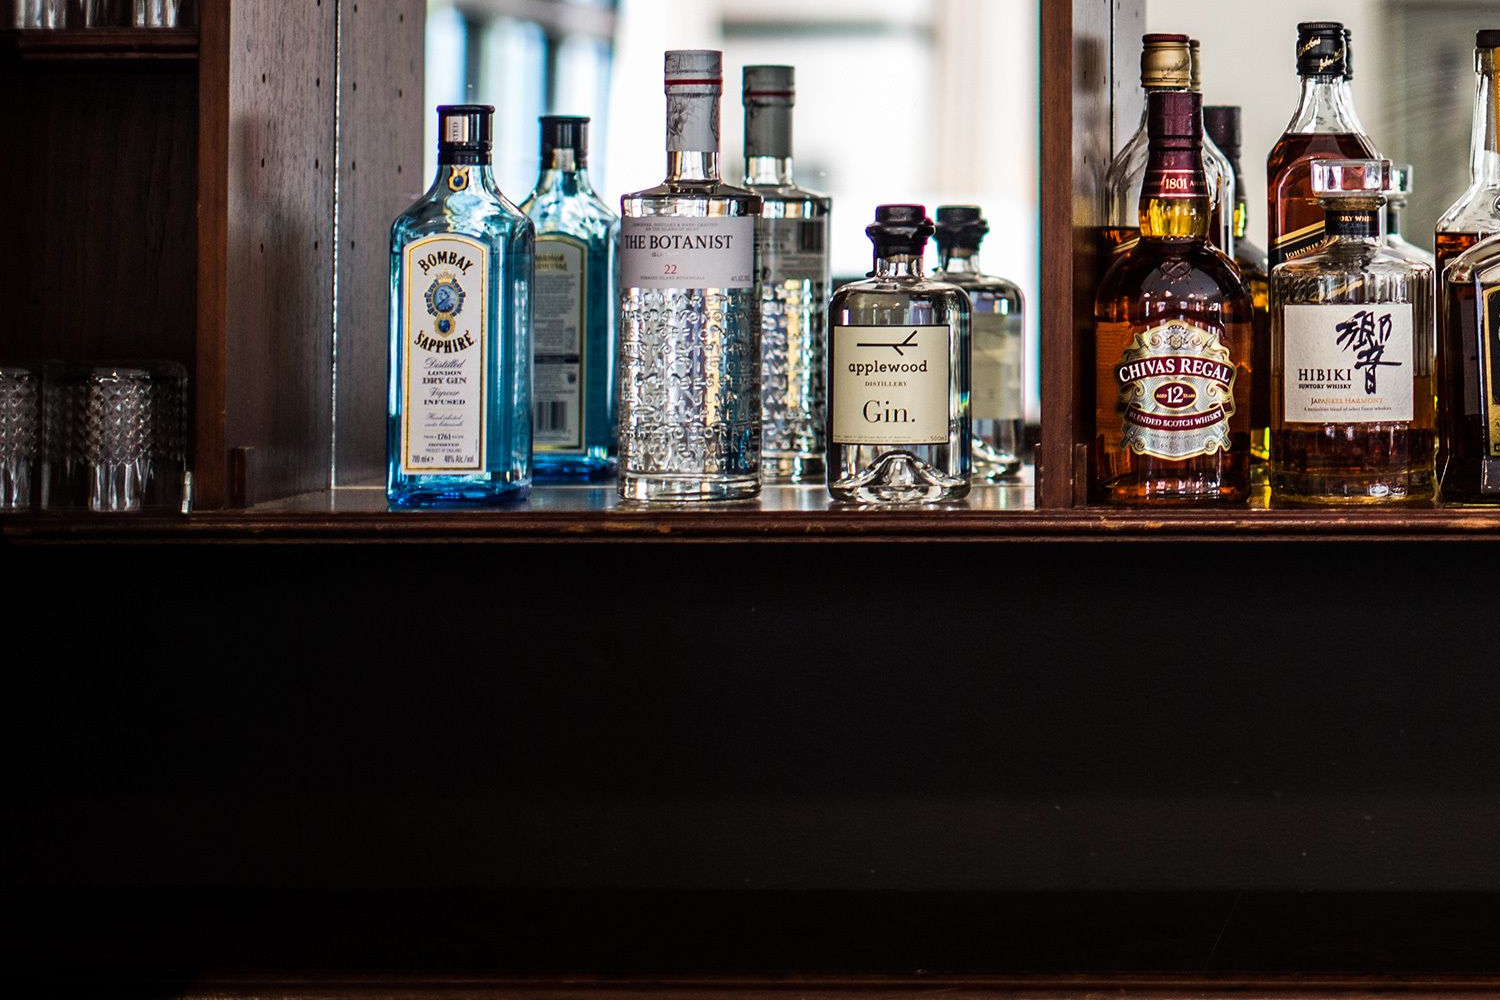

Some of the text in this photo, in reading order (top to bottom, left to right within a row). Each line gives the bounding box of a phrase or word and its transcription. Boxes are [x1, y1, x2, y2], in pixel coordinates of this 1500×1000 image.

[1165, 178, 1188, 190] 1801
[624, 235, 734, 250] THE BOTANIST
[1284, 242, 1320, 260] JOHNNIE
[418, 251, 474, 276] BOMBAY
[664, 264, 677, 275] 22
[414, 330, 474, 354] SAPPHIRE
[424, 356, 466, 369] Distilled
[848, 360, 928, 376] applewood
[1119, 358, 1230, 386] CHIVAS REGAL
[1298, 368, 1352, 382] HIBIKI
[430, 386, 460, 398] Vapour
[1167, 386, 1184, 404] 12
[863, 400, 916, 424] Gin.
[1129, 410, 1222, 427] BLENDED SCOTCH WHISKY
[437, 432, 451, 440] 1761
